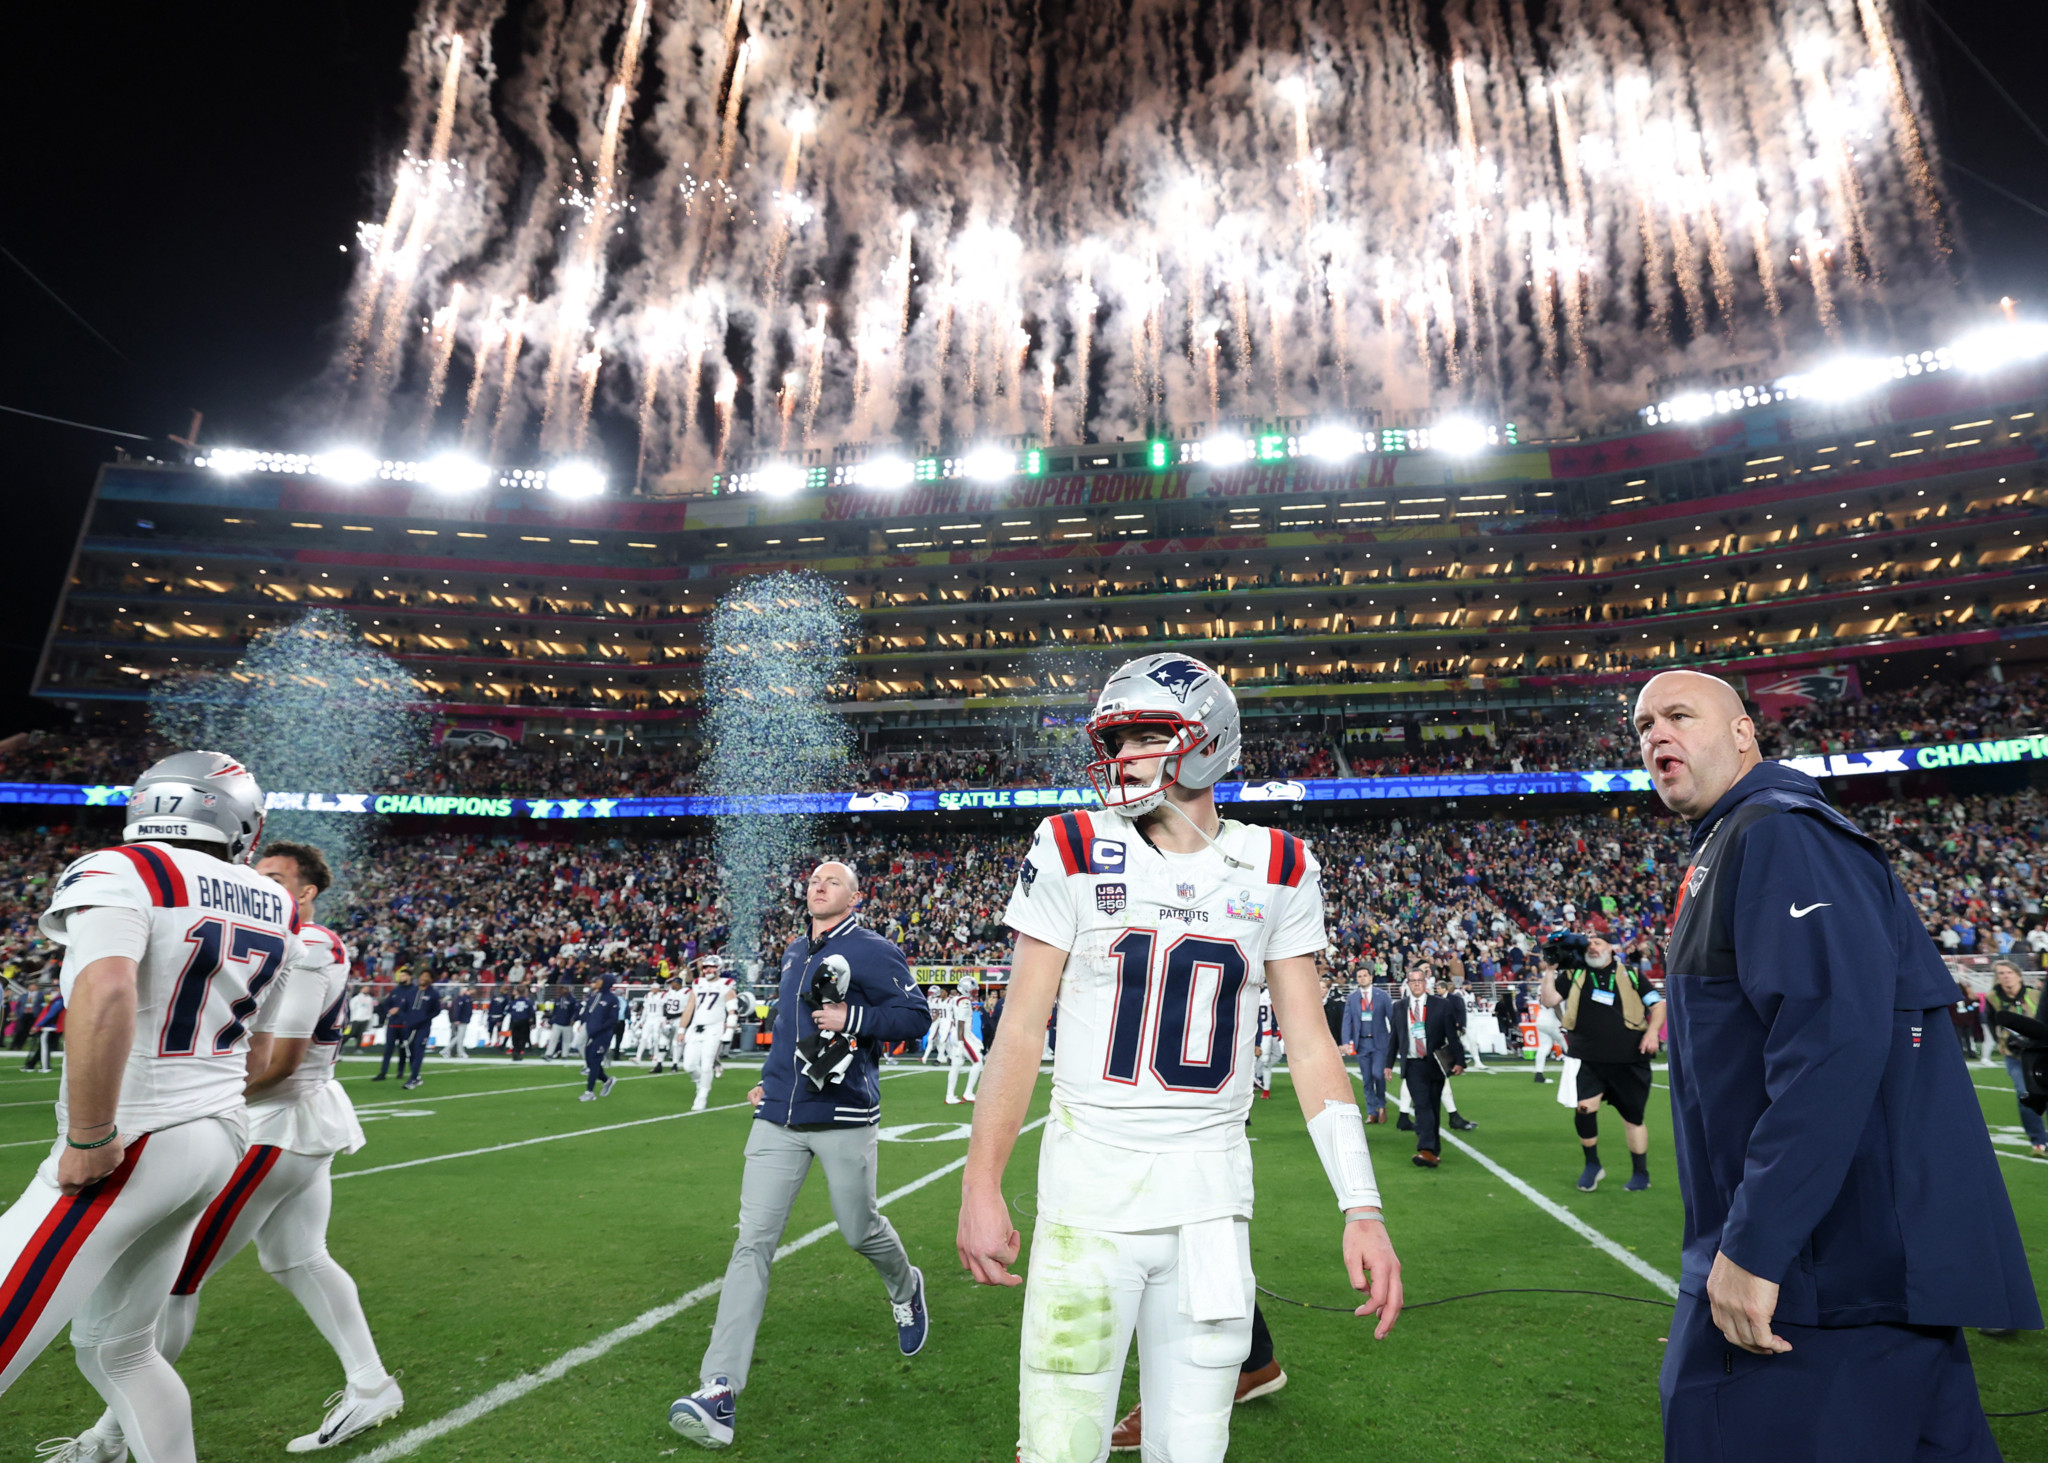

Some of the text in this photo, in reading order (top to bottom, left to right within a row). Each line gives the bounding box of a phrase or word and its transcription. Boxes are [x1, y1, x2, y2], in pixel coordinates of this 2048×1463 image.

[1207, 455, 1399, 497] SUPER BOWL LX
[1010, 469, 1191, 508] SUPER BOWL LX
[154, 795, 184, 814] 17
[374, 795, 512, 817] CHAMPIONS
[938, 791, 1010, 808] SEATTLE
[1013, 789, 1106, 805] SEAH
[138, 824, 188, 836] PATRIOTS
[1092, 840, 1125, 866] C
[197, 875, 283, 925] BARINGER
[1097, 886, 1125, 895] USA
[1179, 889, 1194, 898] NFL
[1097, 900, 1126, 910] 250
[1159, 908, 1209, 923] PATRIOTS
[916, 969, 949, 982] SUPER
[158, 916, 286, 1058] 17
[697, 992, 720, 1011] 77
[1103, 927, 1249, 1095] 10
[1524, 1030, 1536, 1046] G
